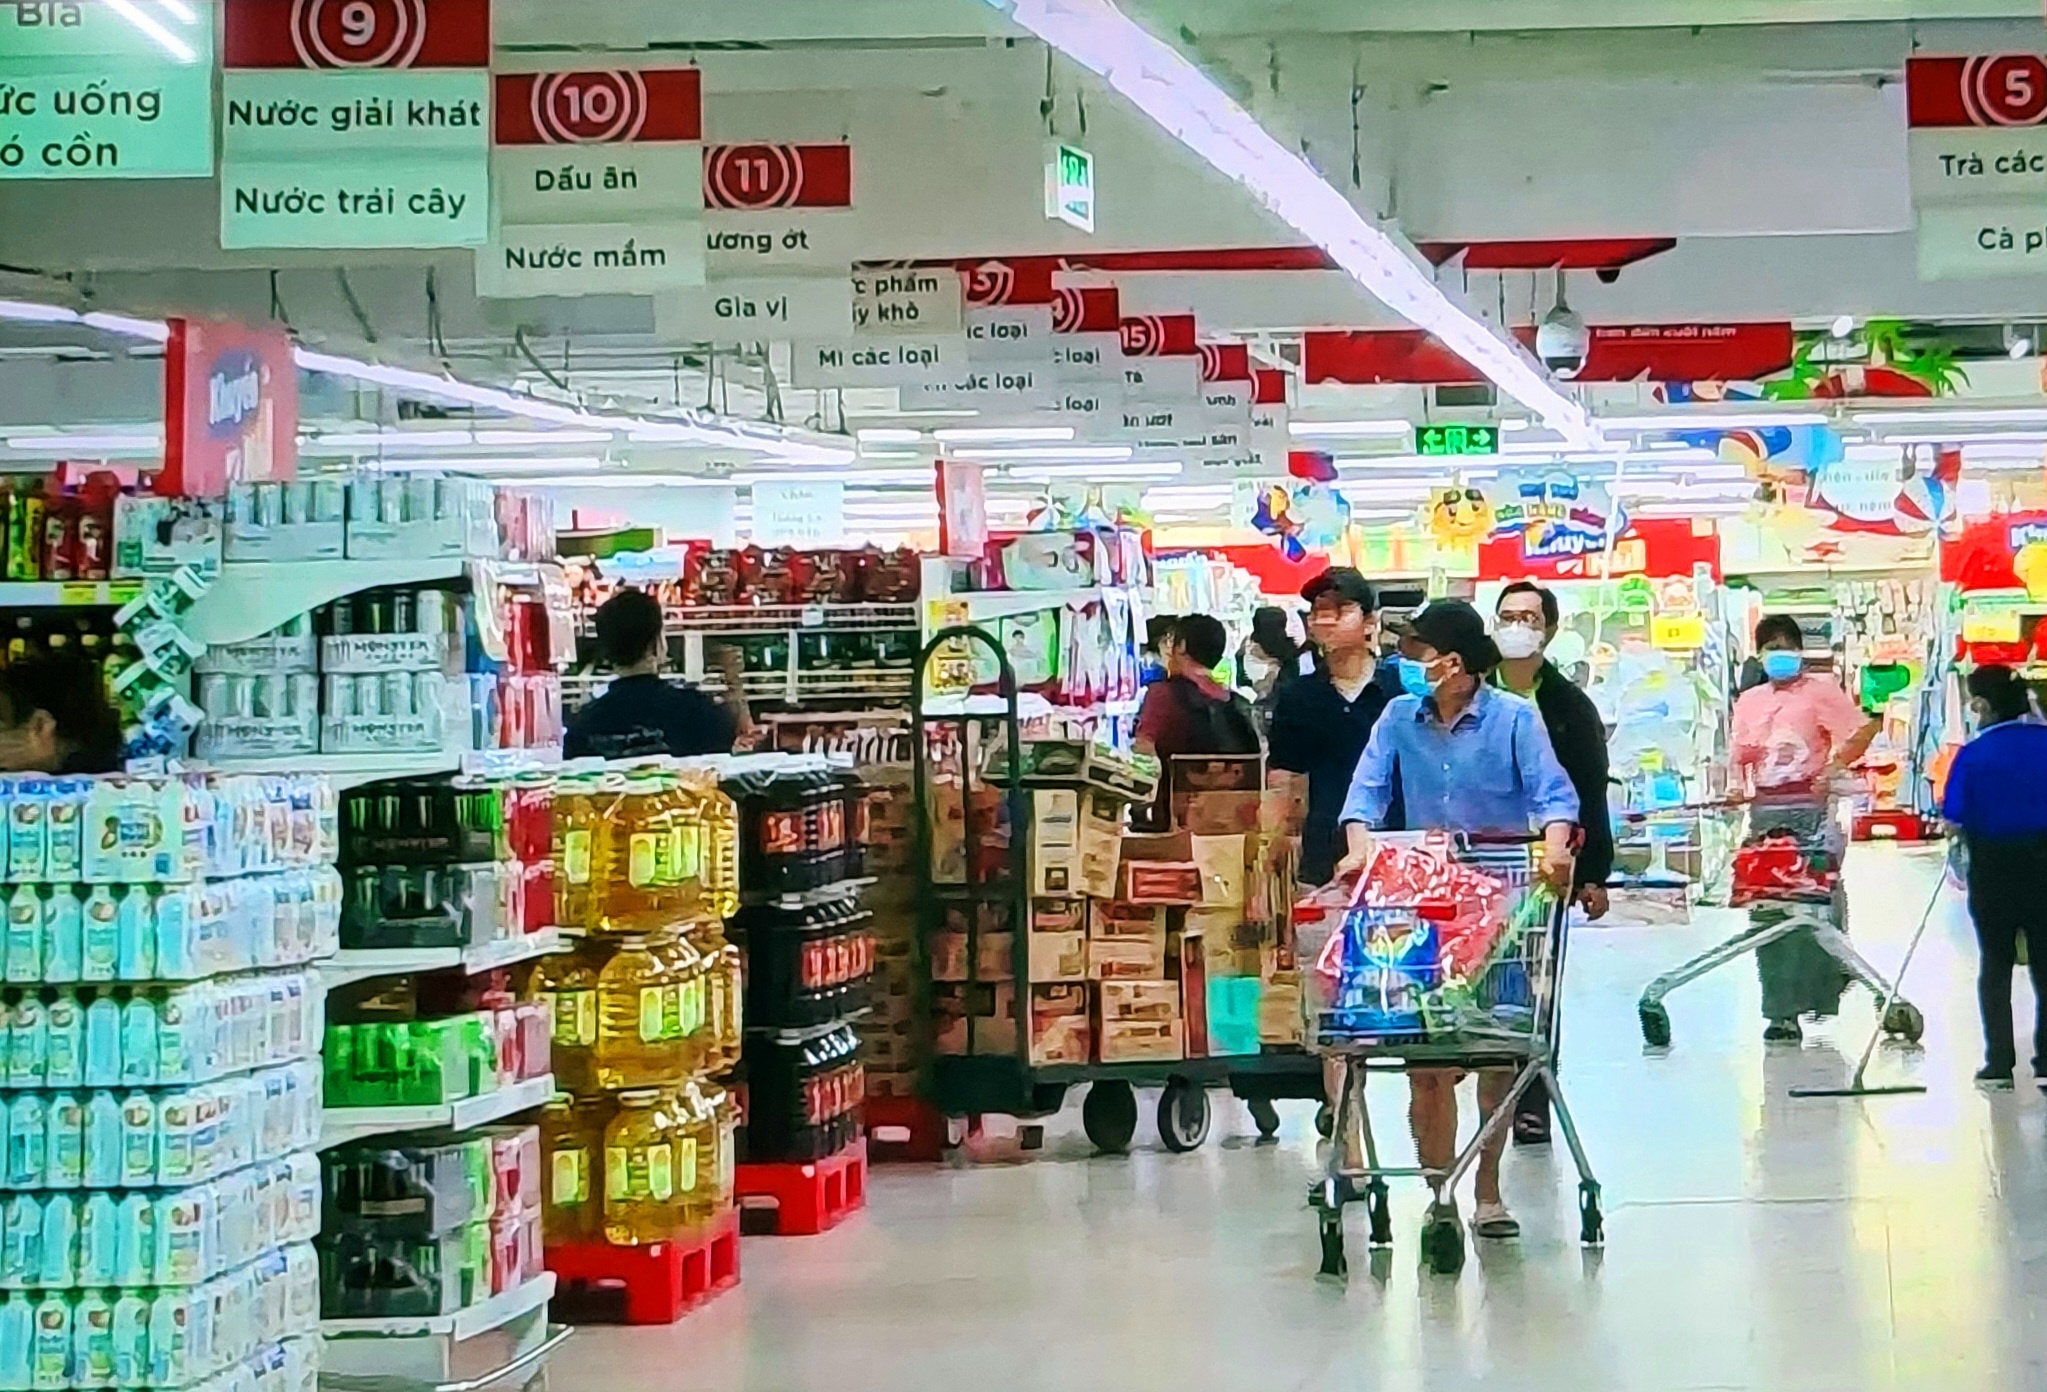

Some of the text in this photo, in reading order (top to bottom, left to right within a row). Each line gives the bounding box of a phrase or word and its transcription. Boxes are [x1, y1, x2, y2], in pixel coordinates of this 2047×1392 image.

[342, 1, 376, 46] 9
[54, 79, 162, 121] uống
[563, 85, 617, 123] 10
[2005, 69, 2032, 107] 5
[228, 97, 481, 131] Nước giải khát
[42, 131, 118, 167] cồn
[1938, 149, 2045, 176] Trà các
[734, 158, 769, 192] 11
[235, 186, 466, 219] Nước trái cây
[505, 238, 666, 269] Nước mắm
[715, 296, 787, 322] Gia vị
[1121, 325, 1147, 348] 15
